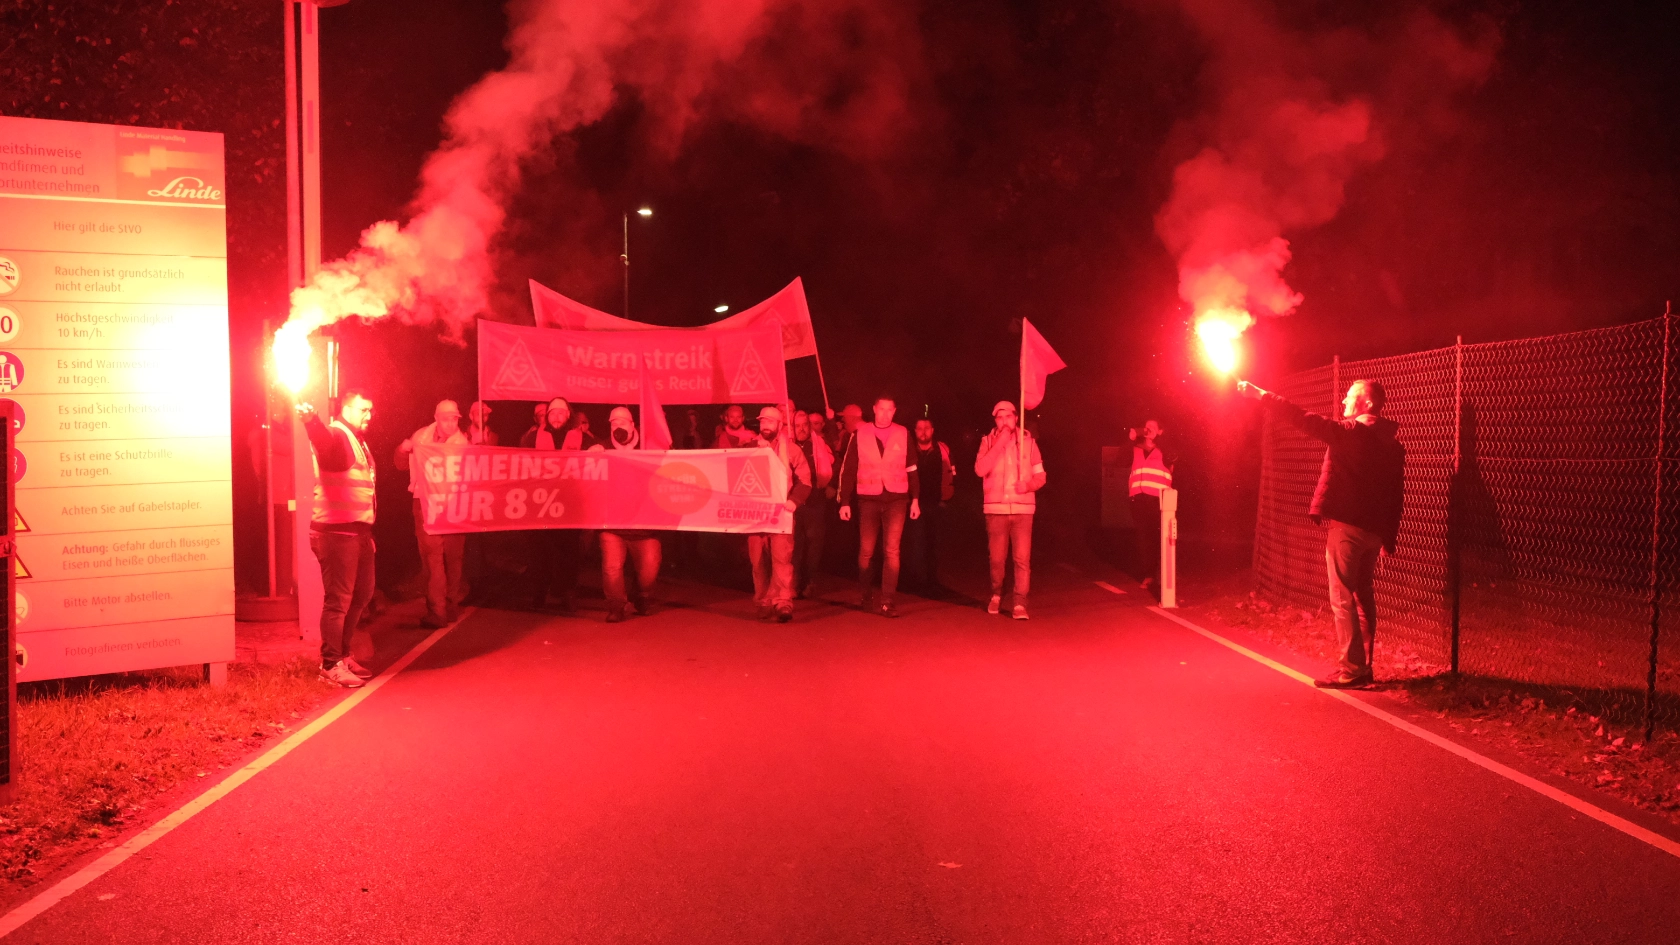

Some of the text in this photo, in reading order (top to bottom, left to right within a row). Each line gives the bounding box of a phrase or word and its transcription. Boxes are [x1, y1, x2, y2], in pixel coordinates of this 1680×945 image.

[0, 143, 82, 159] eitshinweise
[61, 164, 85, 176] und
[147, 176, 221, 200] Linde
[53, 221, 142, 234] Hier gilt die StVO
[55, 266, 185, 280] Rauchen ist grundsätzlich
[55, 281, 125, 293] nicht erlaubt.
[58, 327, 105, 340] 10 km/h.
[57, 359, 68, 369] Es
[72, 359, 93, 369] sind
[567, 345, 712, 369] Warnstreik
[58, 375, 109, 387] zu tragen.
[567, 375, 712, 391] unser gus Recht
[59, 405, 70, 415] Es
[73, 404, 94, 414] sind
[59, 420, 111, 432] zu tragen.
[60, 449, 173, 462] Es ist eine Schutzbrille
[60, 467, 112, 479] zu tragen.
[424, 453, 608, 483] GEMEINSAM
[61, 500, 202, 516] Achten Sie auf Gabelstapler.
[426, 484, 494, 525] FÜR
[62, 537, 221, 556] Achtung: Gefahr durch flüssiges
[62, 553, 208, 570] Eisen und heiße Oberflächen.
[64, 591, 173, 608] Bitte Motor abstellen.
[65, 638, 183, 657] Fotografieren verboten.
